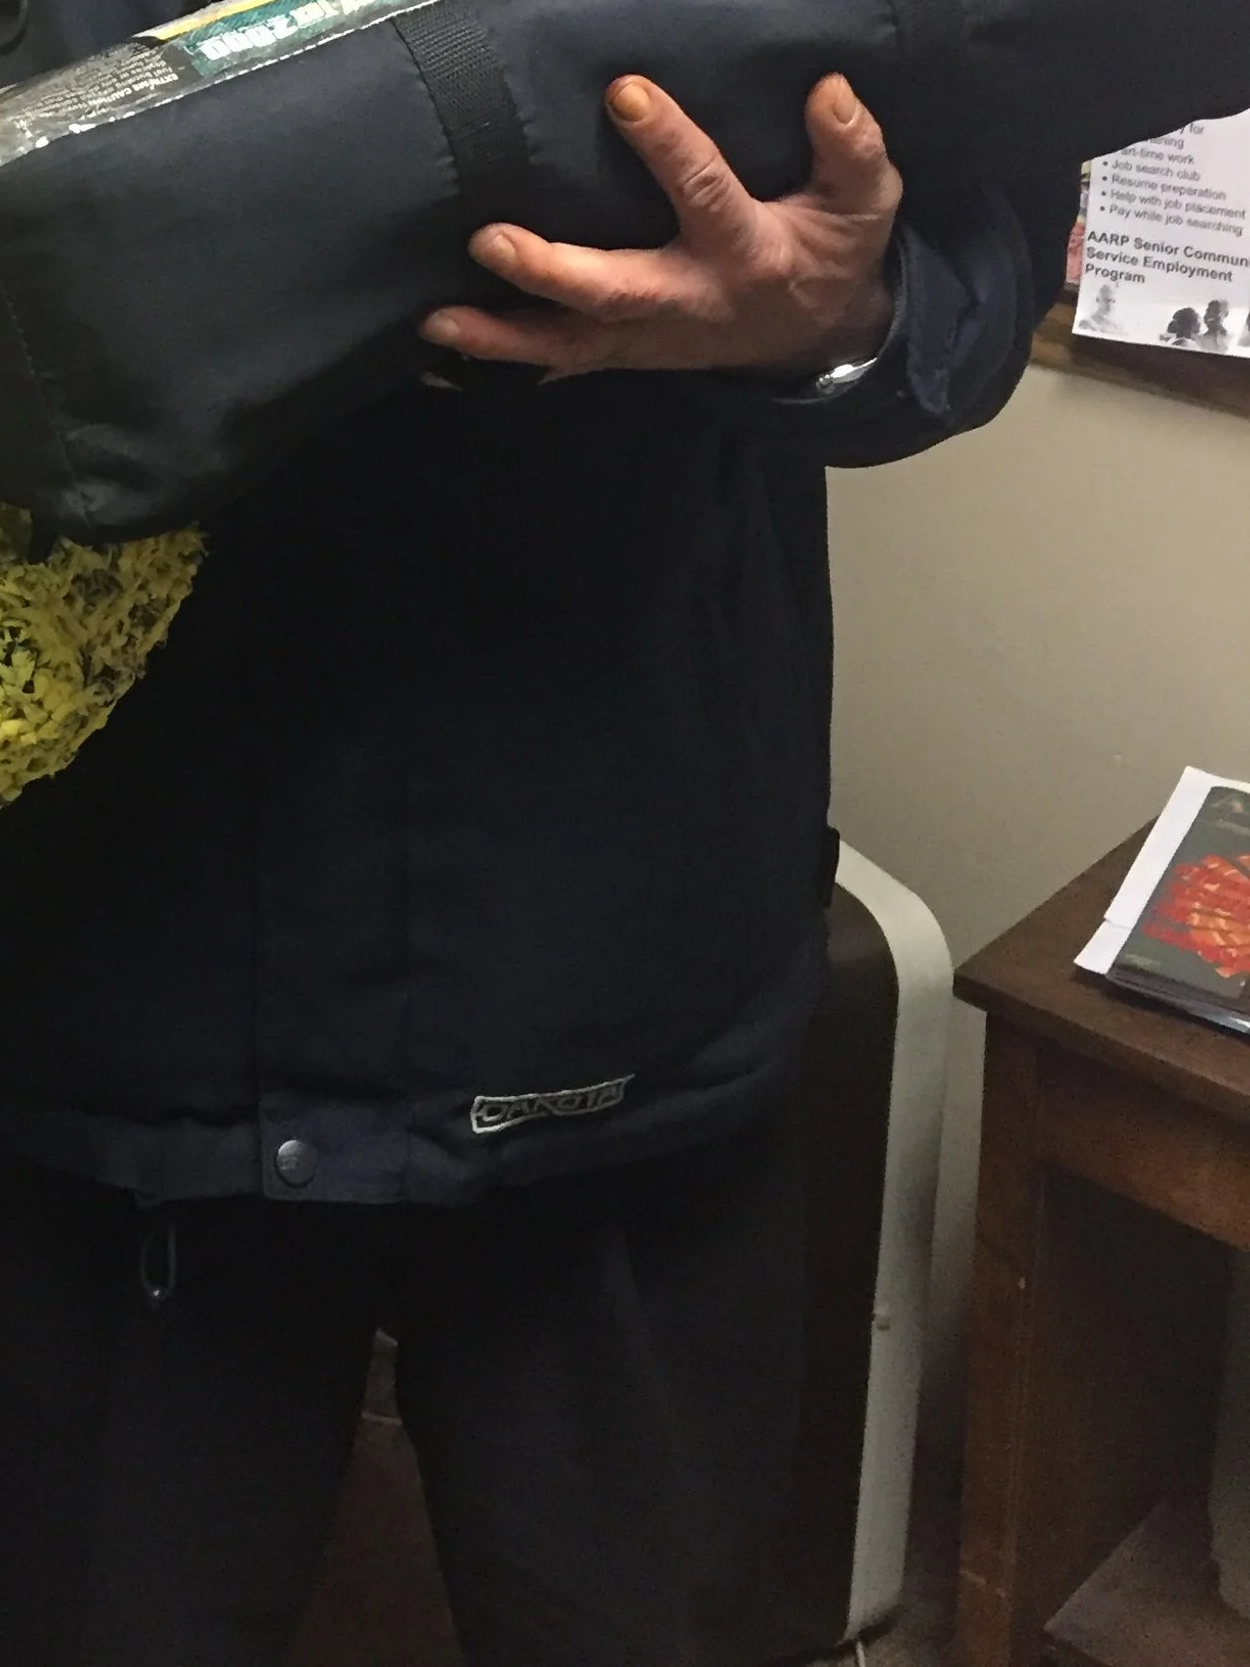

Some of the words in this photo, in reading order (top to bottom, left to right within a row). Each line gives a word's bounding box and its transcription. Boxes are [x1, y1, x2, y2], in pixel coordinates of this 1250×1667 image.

[1119, 147, 1165, 161] art-time
[1167, 154, 1194, 165] work
[1112, 160, 1133, 172] Job
[1135, 163, 1174, 177] search
[1176, 169, 1201, 182] club
[1111, 174, 1158, 191] Resume
[1160, 184, 1227, 201] preparation
[1110, 190, 1137, 203] Help
[1139, 194, 1162, 206] with
[1164, 198, 1183, 211] job
[1185, 202, 1247, 220] placement
[1109, 204, 1132, 219] Pay
[1134, 208, 1163, 222] while
[1165, 213, 1184, 226] job
[1186, 217, 1244, 238] searching
[1087, 230, 1130, 247] AARP
[1133, 236, 1180, 255] Senior
[1183, 245, 1250, 268] Commun
[1085, 263, 1146, 284] Program
[1086, 246, 1139, 266] Service
[1142, 255, 1233, 282] Employment
